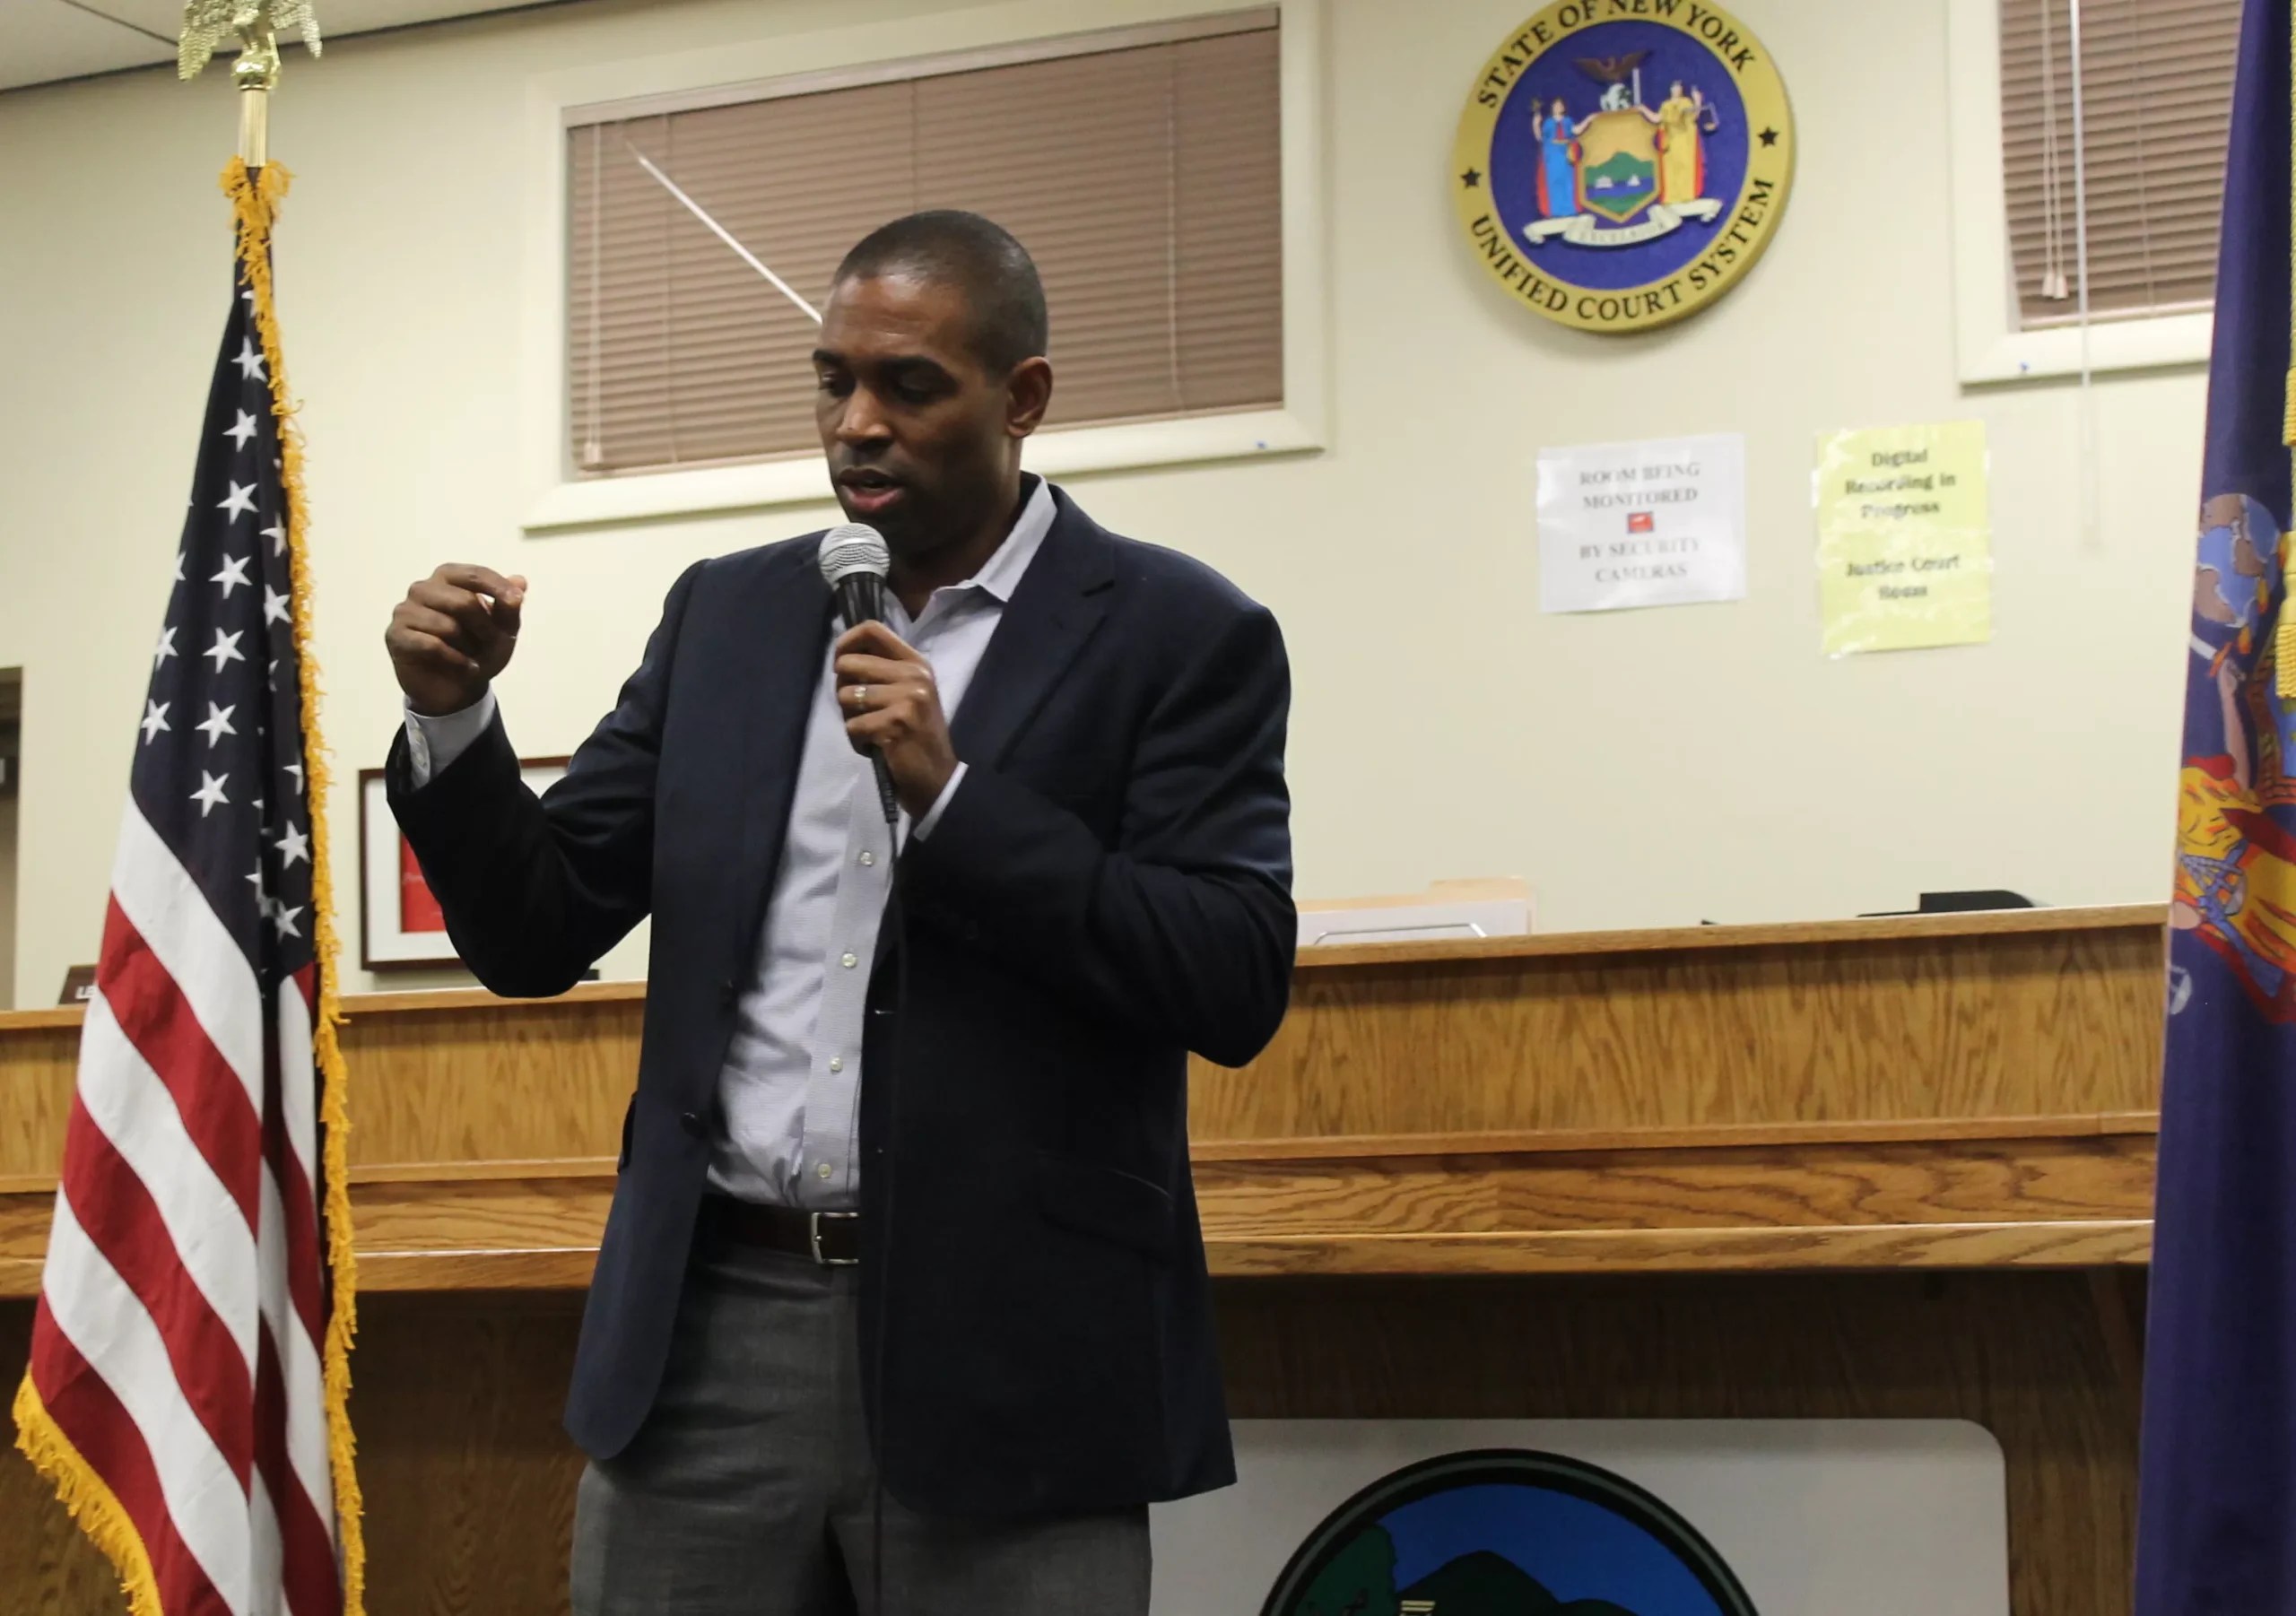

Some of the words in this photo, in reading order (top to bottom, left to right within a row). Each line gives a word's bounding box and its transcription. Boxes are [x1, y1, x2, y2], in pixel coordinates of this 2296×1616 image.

[1478, 21, 1554, 109] STATE
[1558, 0, 1598, 28] OF
[1608, 0, 1680, 17] NEW
[1685, 4, 1755, 73] YORK
[1471, 214, 1569, 313] UNIFIED
[1576, 279, 1683, 321] COURT
[1689, 178, 1775, 291] SYSTEM
[1872, 448, 1929, 467] Digital
[1579, 467, 1636, 485] ROOM
[1643, 462, 1700, 481] BEING
[1846, 474, 1934, 494] Recording
[1583, 488, 1699, 508] MONITORED
[1579, 544, 1600, 560] BY
[1609, 537, 1700, 557] SECURITY
[1595, 562, 1688, 582] CAMERAS
[1912, 554, 1960, 572] Court
